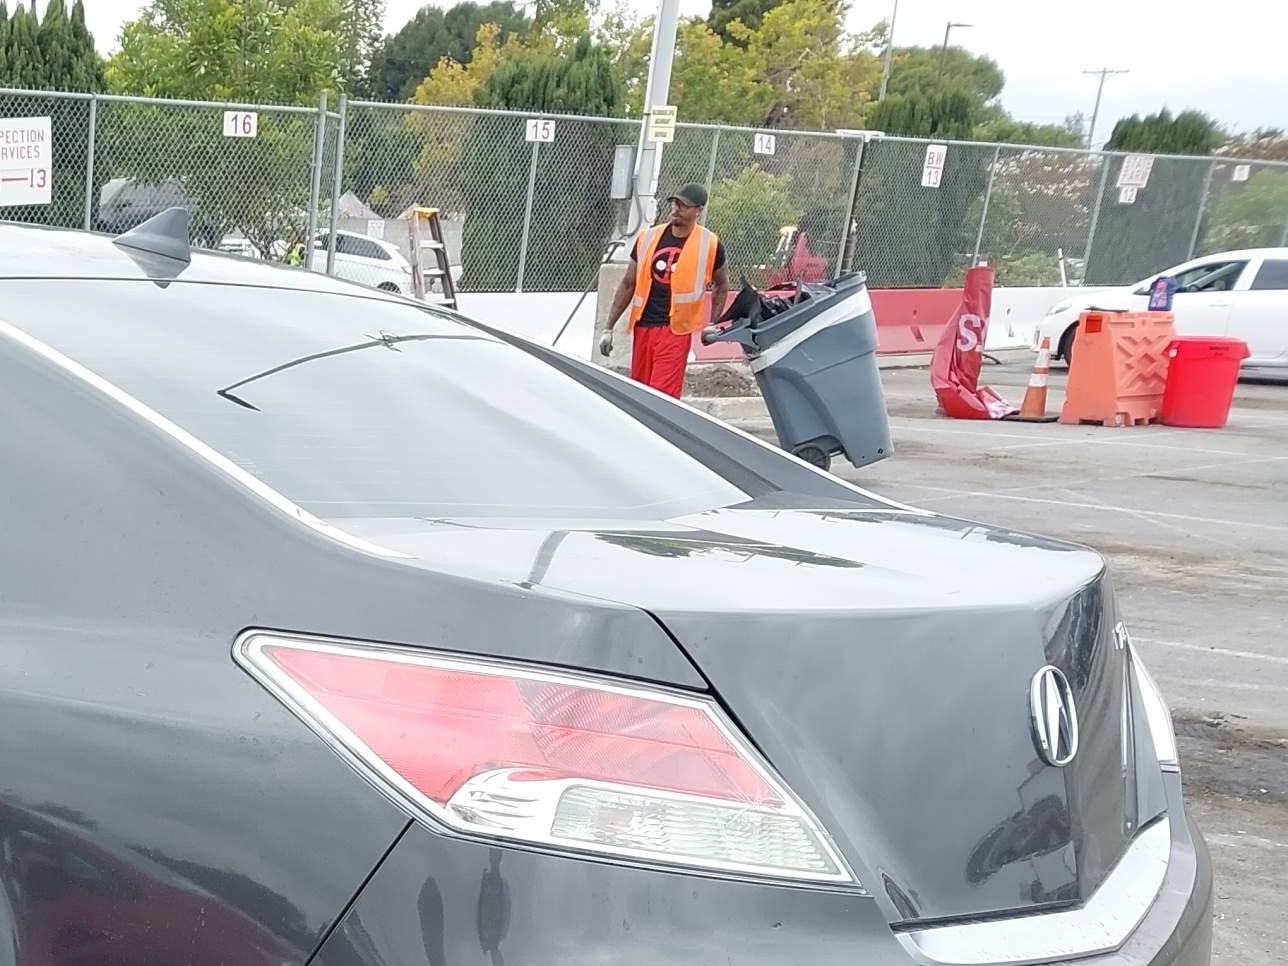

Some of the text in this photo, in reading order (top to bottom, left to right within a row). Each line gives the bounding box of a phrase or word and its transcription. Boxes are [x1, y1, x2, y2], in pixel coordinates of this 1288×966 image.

[231, 113, 252, 135] 16
[532, 121, 550, 140] 15
[759, 135, 772, 153] 14
[927, 151, 944, 166] BW
[927, 170, 940, 186] 13
